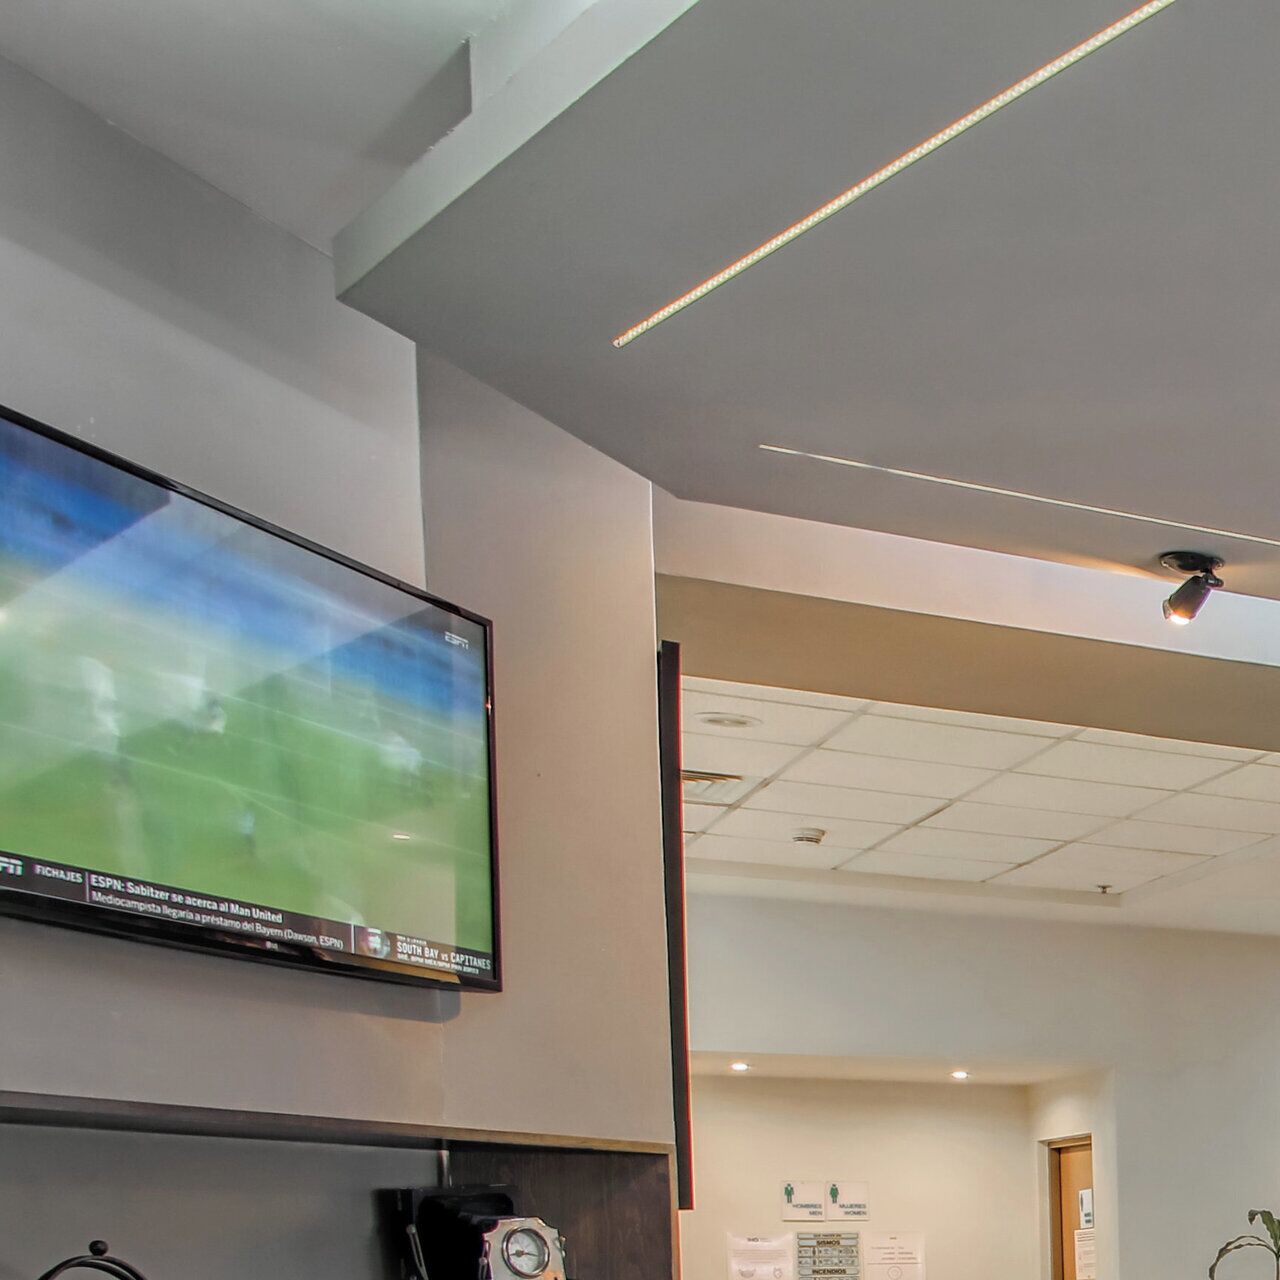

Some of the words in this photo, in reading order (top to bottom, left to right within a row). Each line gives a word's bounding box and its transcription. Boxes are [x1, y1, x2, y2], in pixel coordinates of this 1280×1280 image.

[35, 864, 83, 882] FICHAJES
[91, 874, 125, 892] ESPN:
[126, 881, 170, 900] Sabitzer
[171, 891, 184, 903] se
[185, 895, 218, 911] acerca
[219, 902, 229, 913] al
[230, 903, 251, 918] Man
[252, 908, 283, 924] United
[91, 890, 162, 914] Mediocampista
[242, 920, 255, 932] del
[255, 923, 283, 938] Bayern
[319, 936, 344, 950] ESPN)
[396, 941, 423, 956] SOUTH
[424, 947, 439, 960] BAY
[450, 952, 492, 970] CAPITANES
